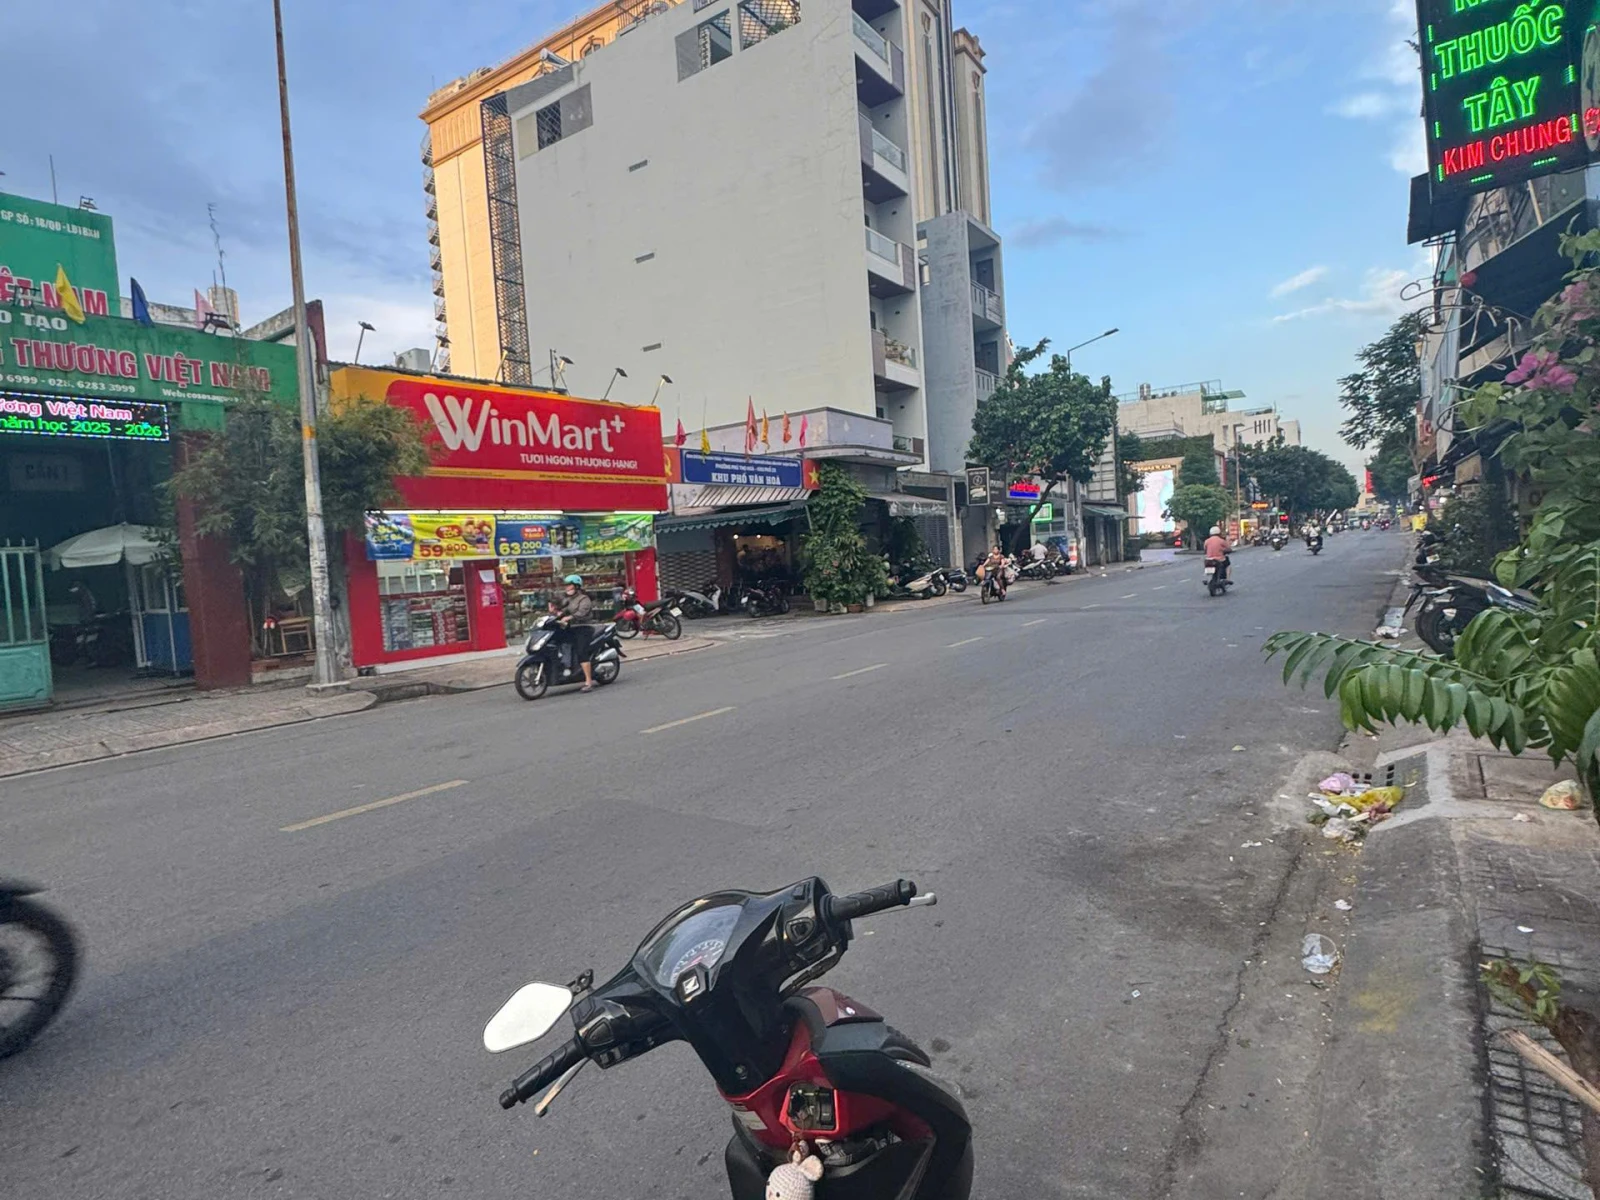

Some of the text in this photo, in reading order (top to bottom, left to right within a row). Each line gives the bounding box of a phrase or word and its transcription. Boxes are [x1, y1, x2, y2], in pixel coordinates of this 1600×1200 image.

[1434, 0, 1564, 79] THUỐC
[1463, 76, 1540, 132] TÂY
[1444, 141, 1484, 175] KIM
[1490, 116, 1572, 161] CHUNG
[20, 313, 68, 331] TẠO
[10, 337, 138, 378] THƯƠNG
[144, 352, 204, 388] VIỆT
[6, 374, 38, 384] 6999
[77, 380, 106, 391] 6283
[108, 383, 136, 393] 3999
[45, 400, 88, 419] Việt
[89, 403, 132, 420] Nam
[0, 415, 35, 429] năm
[38, 418, 68, 433] học
[70, 420, 111, 433] 2025
[124, 423, 162, 437] 2026
[545, 455, 573, 466] NGON
[711, 472, 729, 482] KHU
[731, 472, 747, 483] PHỐ
